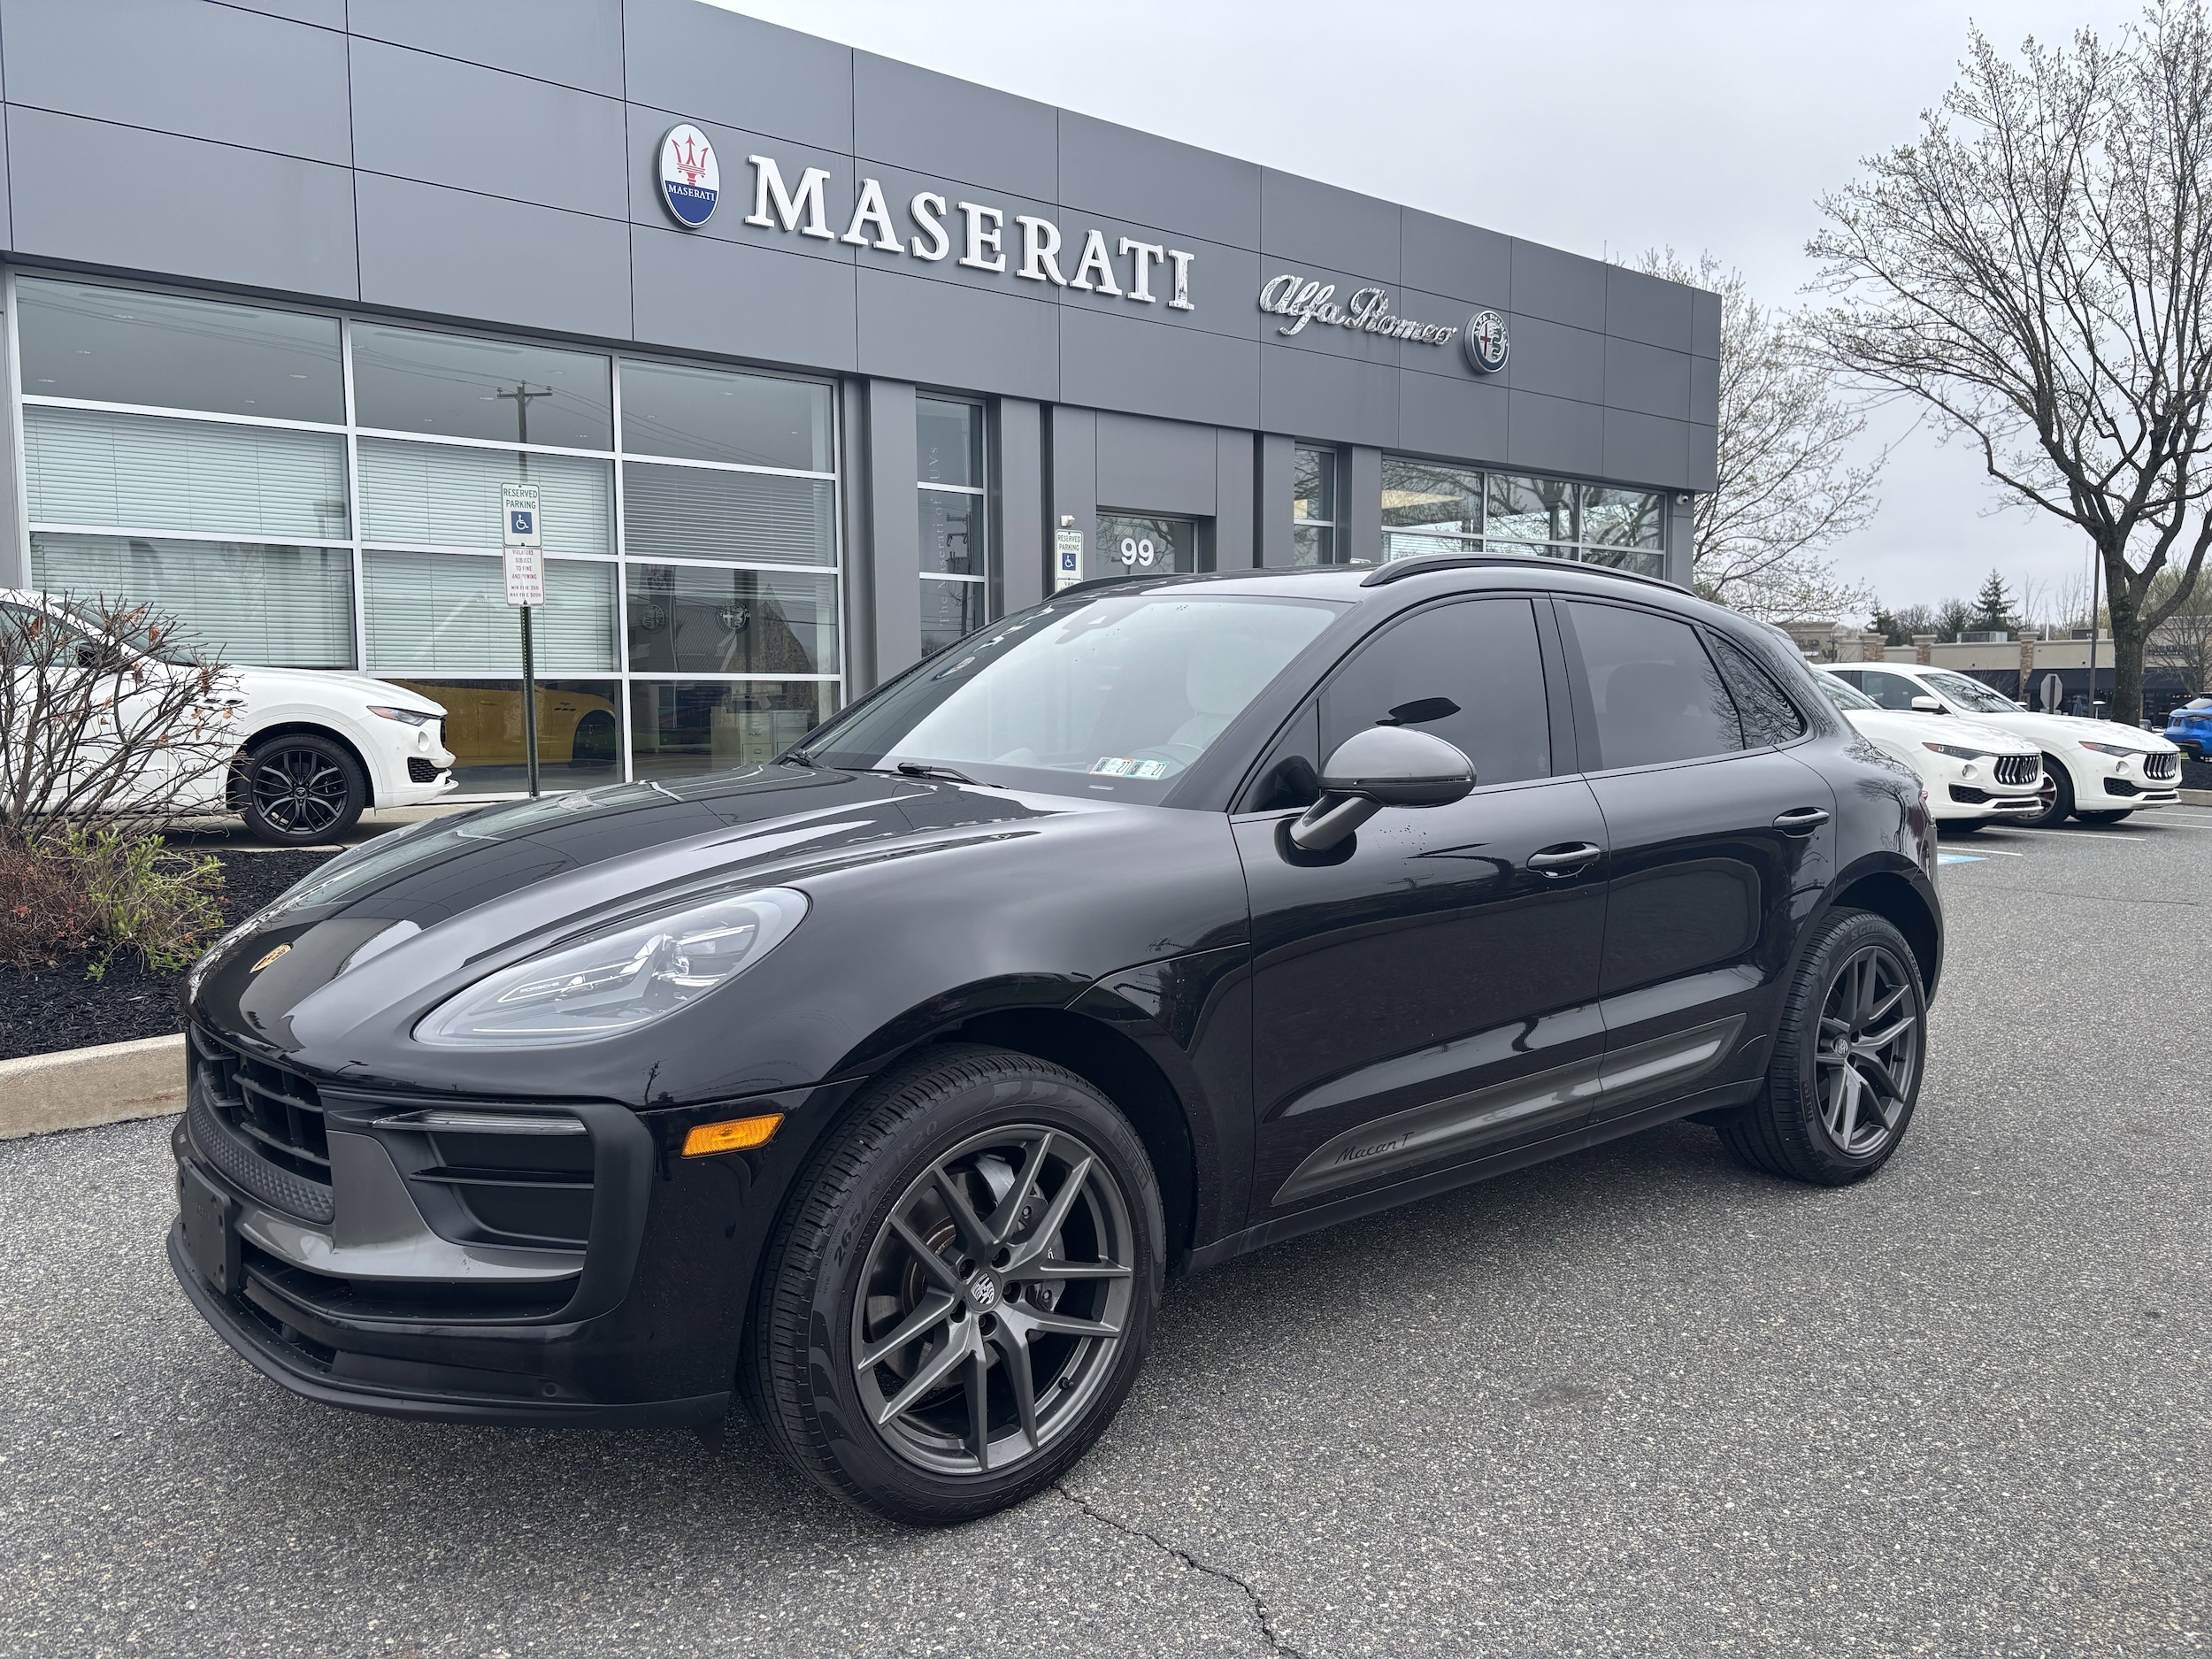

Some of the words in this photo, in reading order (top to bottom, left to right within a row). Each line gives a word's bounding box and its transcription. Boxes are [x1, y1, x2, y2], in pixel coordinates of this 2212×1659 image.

[668, 183, 715, 202] MASERATI
[744, 154, 1195, 311] MASERATI
[1258, 273, 1346, 336] Alfa
[1343, 287, 1458, 345] Romeo
[1474, 314, 1487, 336] ALFA
[1489, 313, 1509, 347] ROMO
[929, 447, 941, 480] UVs
[503, 488, 538, 499] RESERVED
[505, 499, 536, 510] PARKING
[1057, 534, 1081, 543] RESERVED
[1121, 537, 1154, 567] 99
[938, 596, 950, 626] The
[1334, 1141, 1397, 1164] Macan
[1402, 1132, 1416, 1148] T
